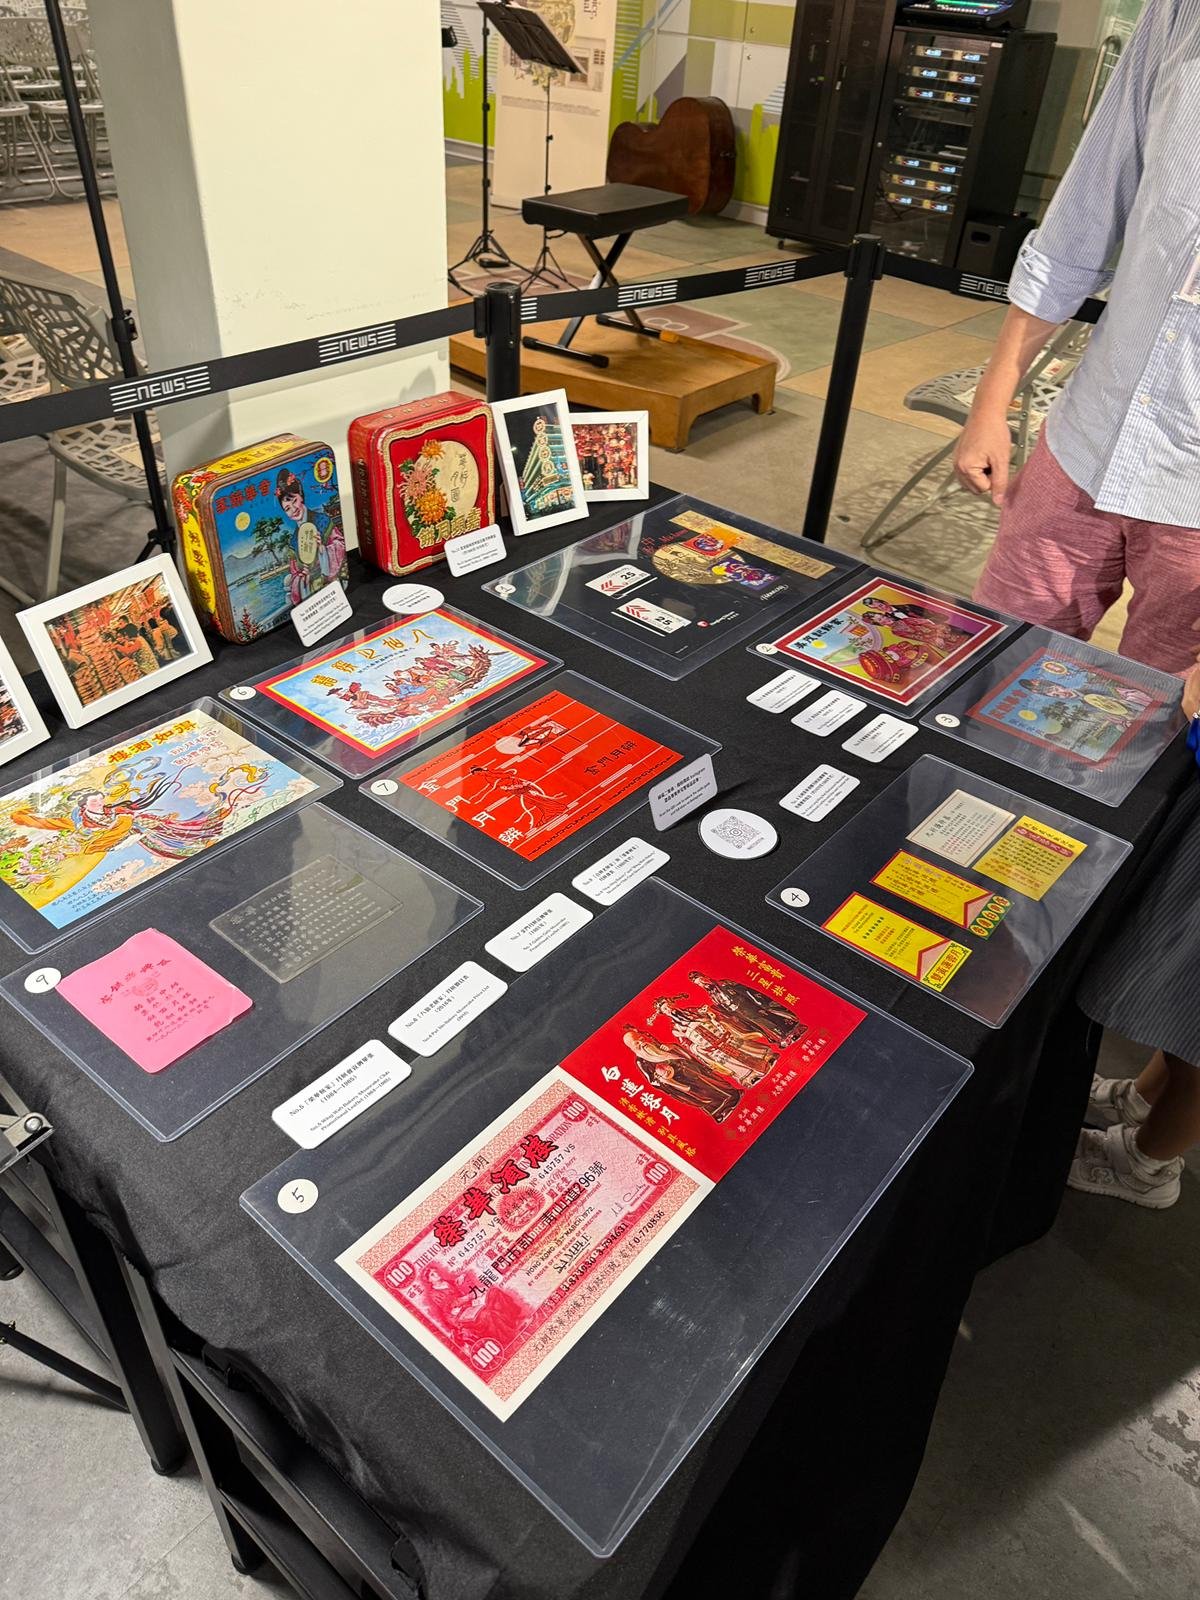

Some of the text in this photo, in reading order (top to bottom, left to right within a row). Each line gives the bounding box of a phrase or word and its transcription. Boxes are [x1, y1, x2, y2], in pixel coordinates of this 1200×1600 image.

[758, 266, 783, 281] NEWS
[633, 285, 663, 301] NEWS
[339, 333, 378, 353] NEWS
[136, 376, 187, 401] NEWS
[620, 571, 636, 580] 25
[655, 616, 674, 626] 25
[729, 943, 788, 981] 榮華富貴
[743, 967, 801, 1006] 三星拱照
[596, 1060, 684, 1128] 白蓮蓉月
[562, 1100, 586, 1120] 100
[454, 1154, 491, 1184] 元朗
[536, 1152, 566, 1179] 645757
[562, 1142, 576, 1154] VS
[644, 1161, 670, 1183] 100
[293, 1188, 307, 1204] 5
[419, 1128, 565, 1255] 榮華酒樓
[464, 1231, 537, 1300] 九龍門市部
[537, 1159, 609, 1226] 青山道296號
[631, 1208, 665, 1245] 0-770836
[456, 1228, 489, 1258] 645757
[550, 1231, 594, 1274] SAMPLE
[385, 1260, 414, 1286] 100
[472, 1338, 501, 1367] 100
